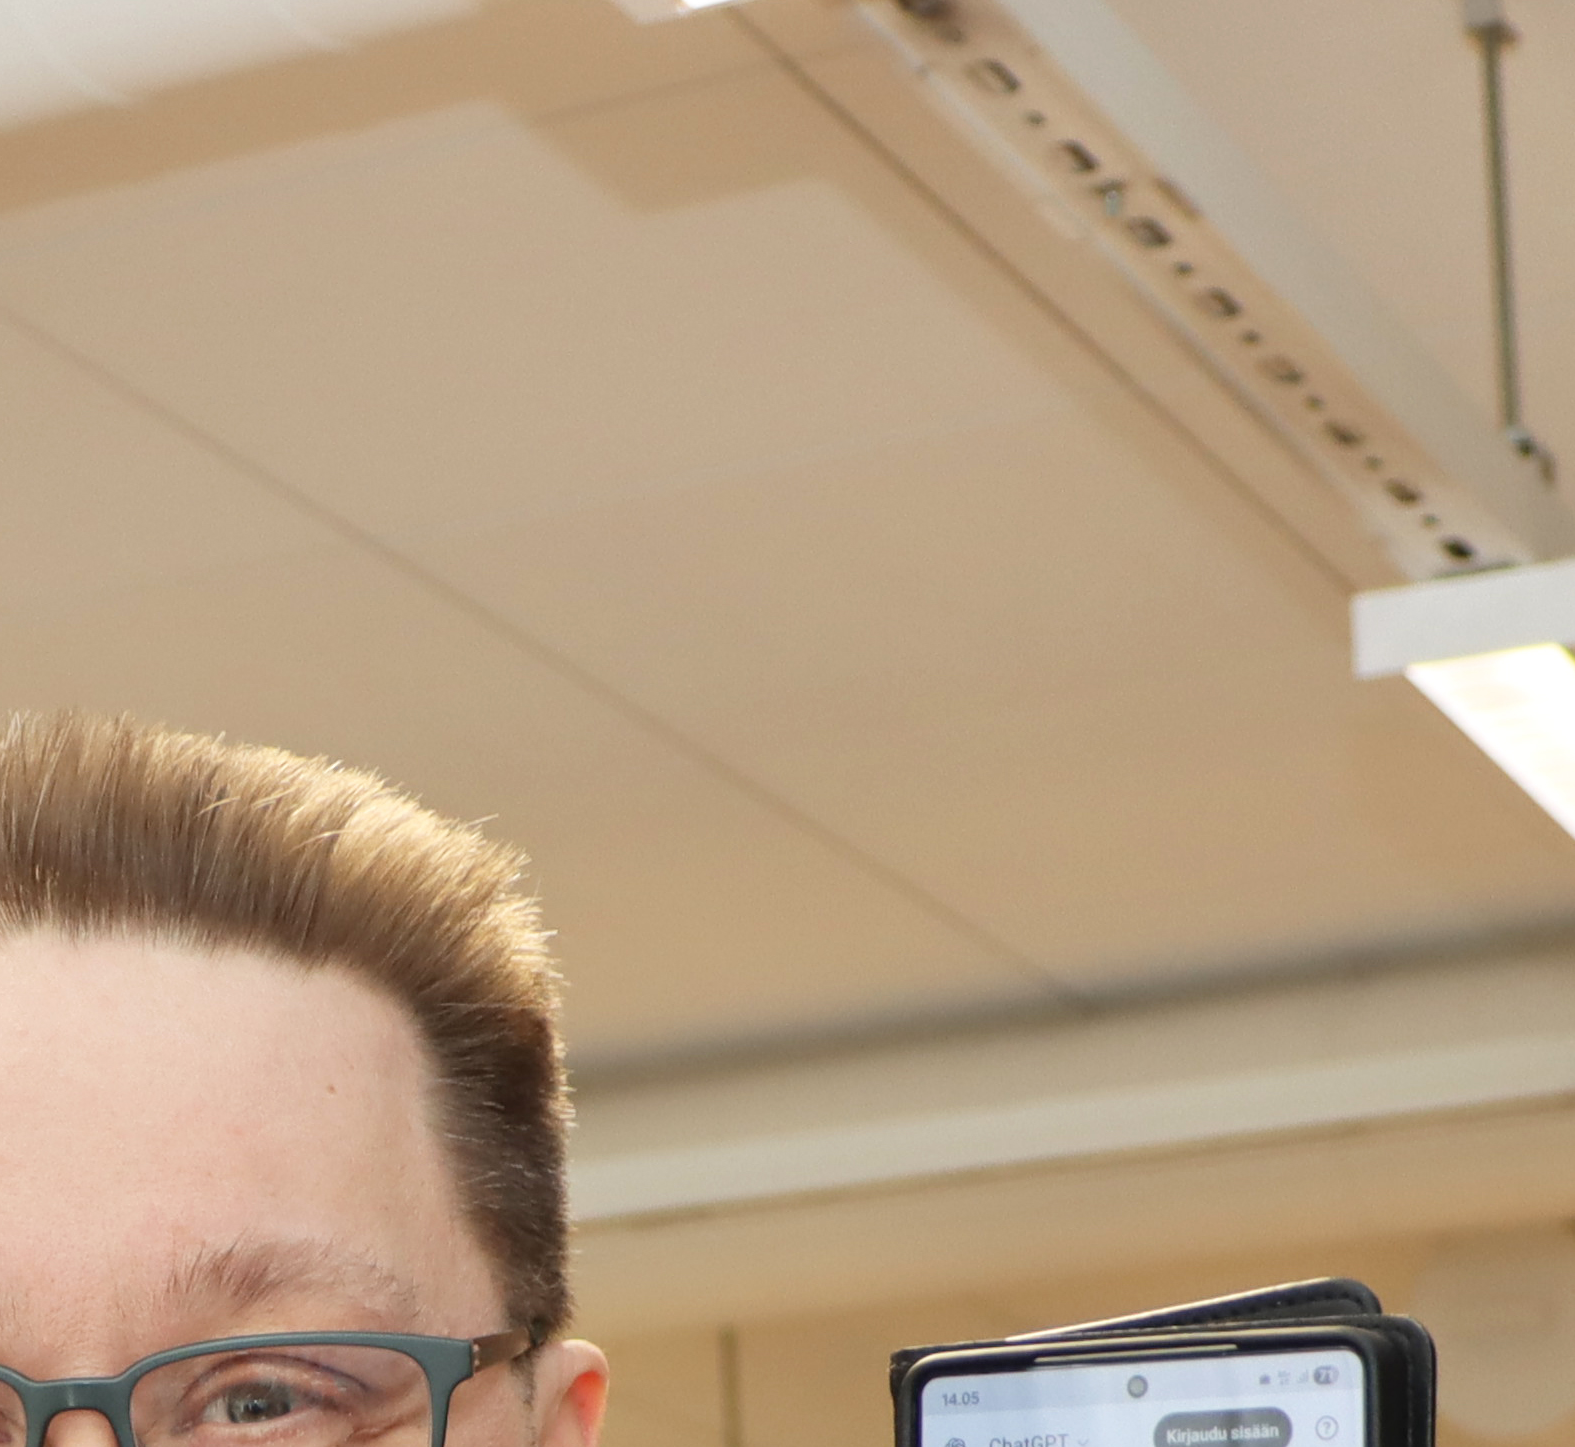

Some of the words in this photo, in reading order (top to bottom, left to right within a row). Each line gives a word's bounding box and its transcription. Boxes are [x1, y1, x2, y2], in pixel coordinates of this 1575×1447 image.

[942, 1391, 980, 1407] 14.05
[1166, 1425, 1228, 1446] Kirjaudu
[1230, 1424, 1280, 1441] sisään
